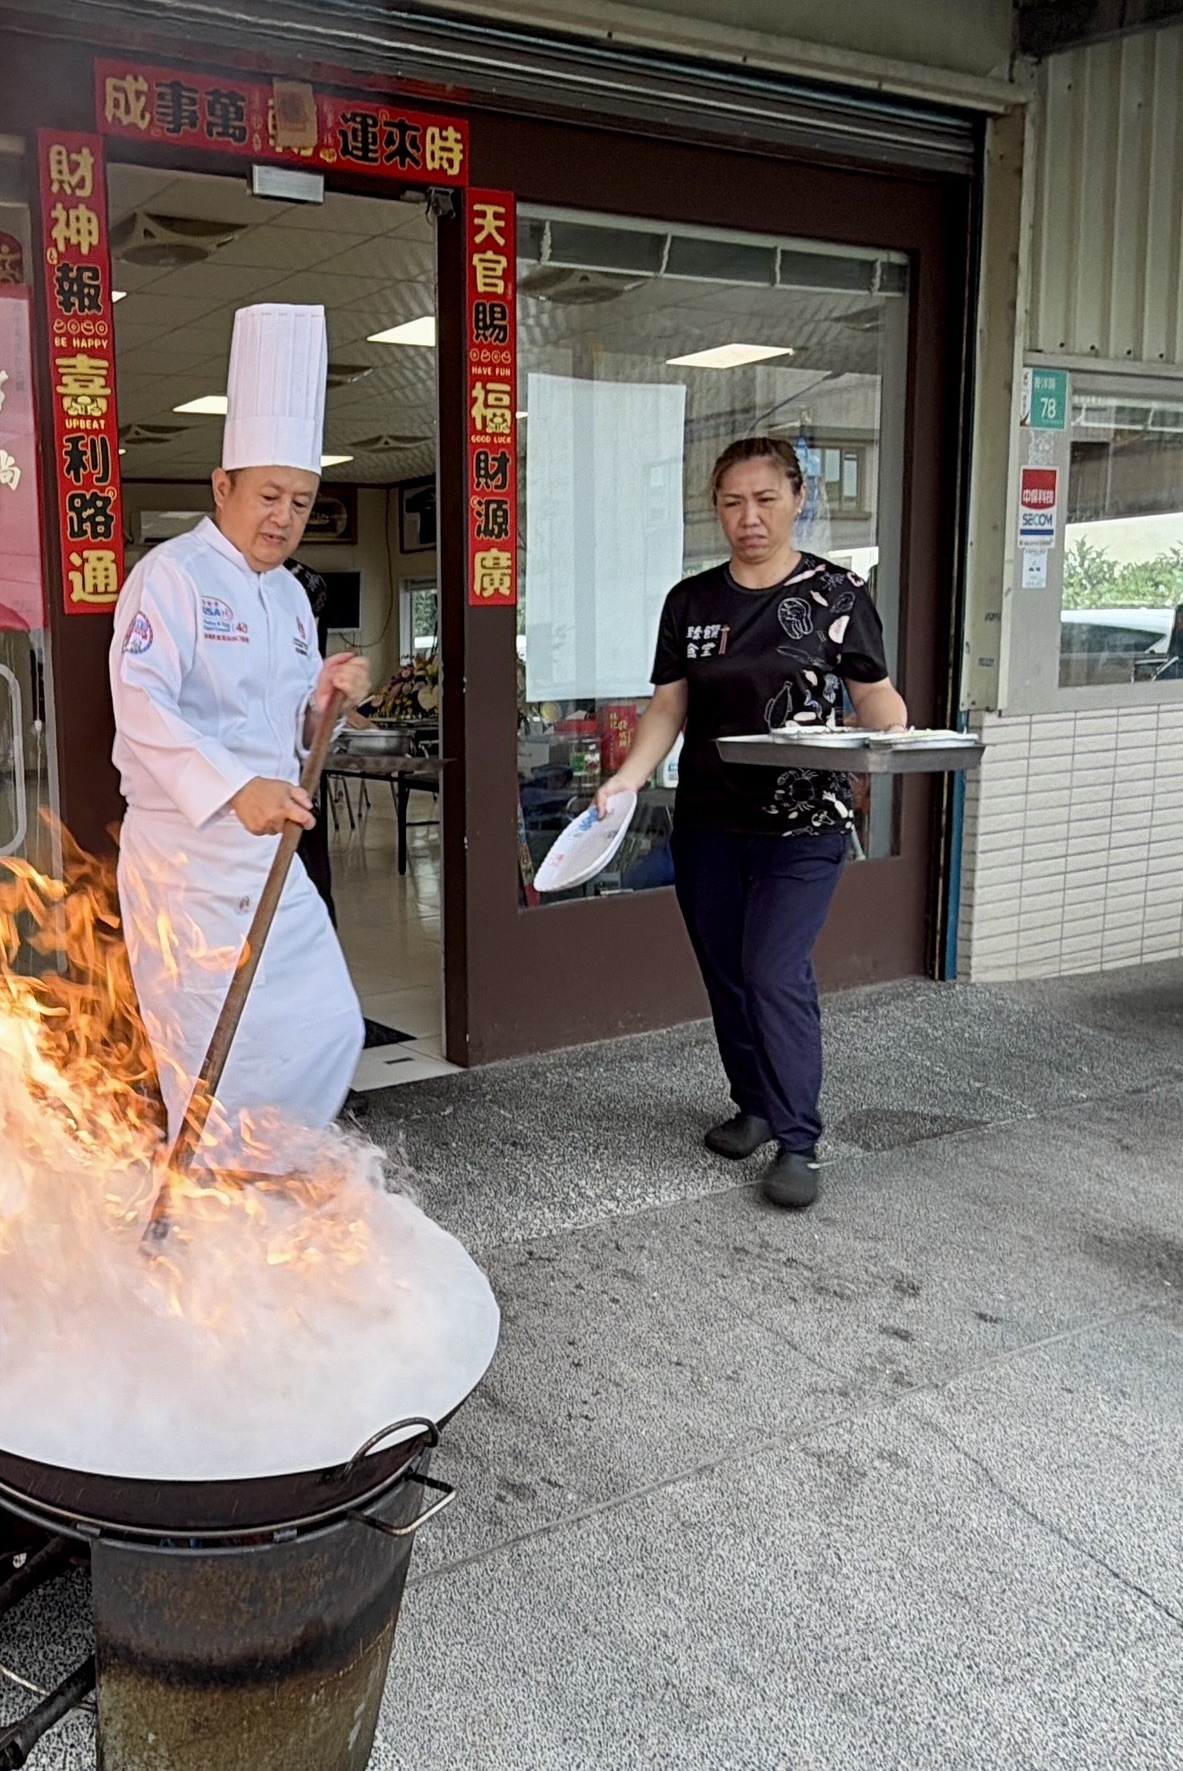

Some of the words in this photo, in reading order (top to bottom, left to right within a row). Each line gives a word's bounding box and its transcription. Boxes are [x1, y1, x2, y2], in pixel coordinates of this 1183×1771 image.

[54, 337, 67, 347] BE
[72, 338, 109, 350] HAPPY
[495, 367, 511, 377] FUN
[1040, 398, 1056, 419] 78
[65, 419, 106, 430] UPBEAT
[471, 434, 491, 444] GOOD
[493, 435, 512, 444] LUCK
[1022, 513, 1053, 526] SECOM
